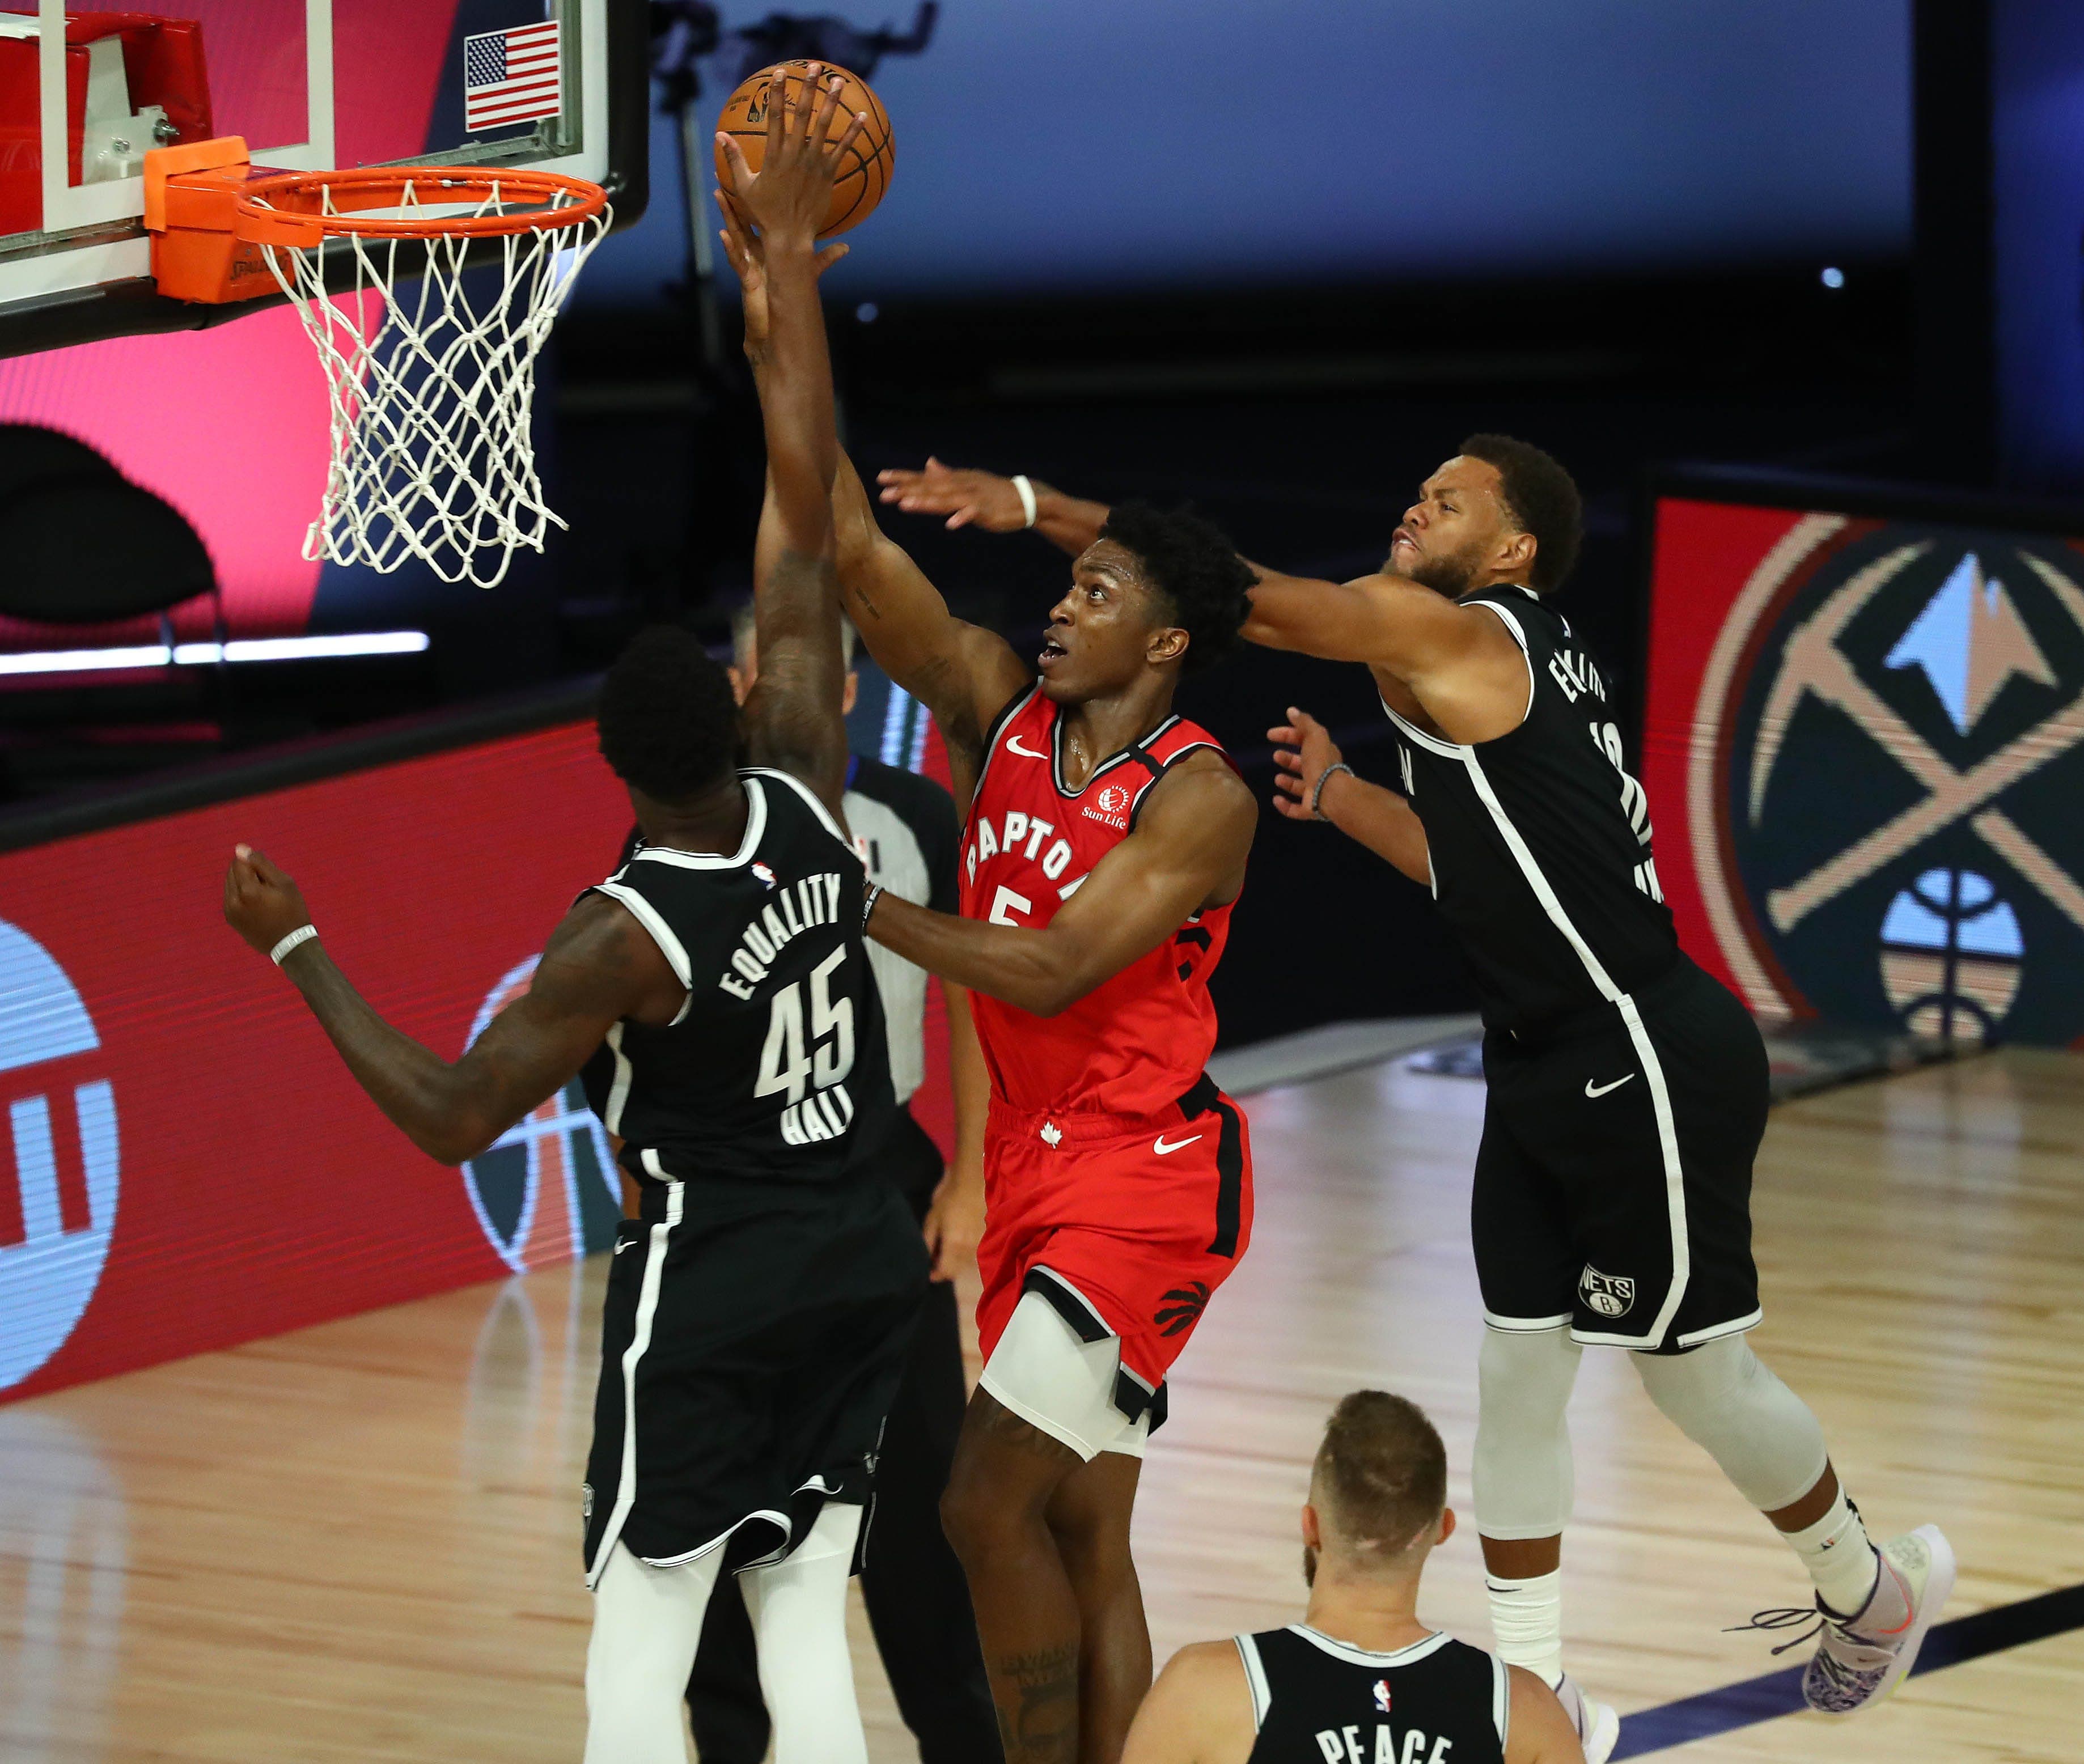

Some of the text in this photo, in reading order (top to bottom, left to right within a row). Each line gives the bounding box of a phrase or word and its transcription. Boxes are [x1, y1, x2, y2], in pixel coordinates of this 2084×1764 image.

[1081, 806, 1126, 830] Sun Life
[966, 811, 1090, 901] RAPTO
[718, 872, 841, 1001] EQUALITY
[753, 942, 855, 1106] 45
[1579, 1265, 1632, 1299] NETS
[1314, 1723, 1453, 1764] PEACE
